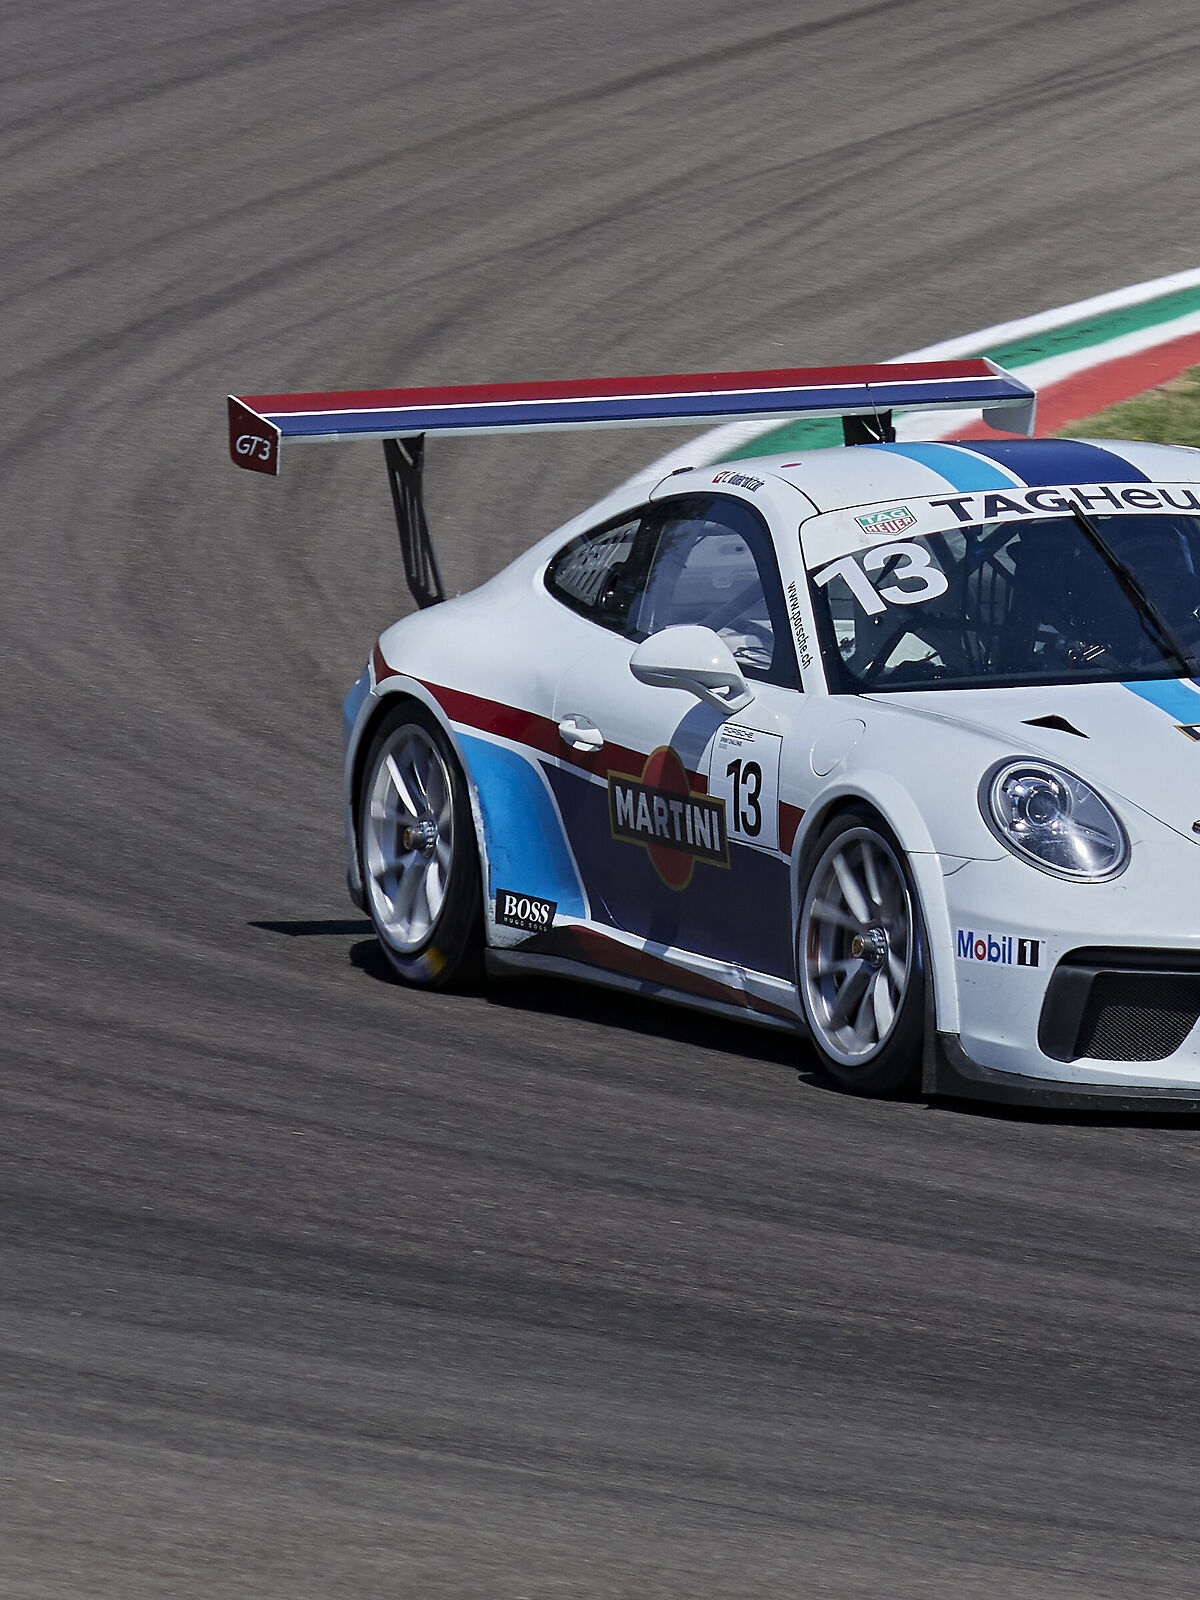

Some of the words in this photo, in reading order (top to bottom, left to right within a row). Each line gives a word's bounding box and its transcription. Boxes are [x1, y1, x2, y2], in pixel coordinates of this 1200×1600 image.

[236, 434, 271, 460] GT3
[859, 507, 908, 524] TAG
[865, 516, 914, 533] HEUER
[813, 542, 949, 616] 13
[787, 581, 814, 669] www.porsche.ch
[723, 726, 755, 739] PORSCHE
[726, 758, 762, 837] 13
[615, 785, 721, 851] MARTINI
[503, 894, 550, 925] BOSS
[957, 929, 1013, 965] Mobil
[1021, 939, 1034, 966] 1
